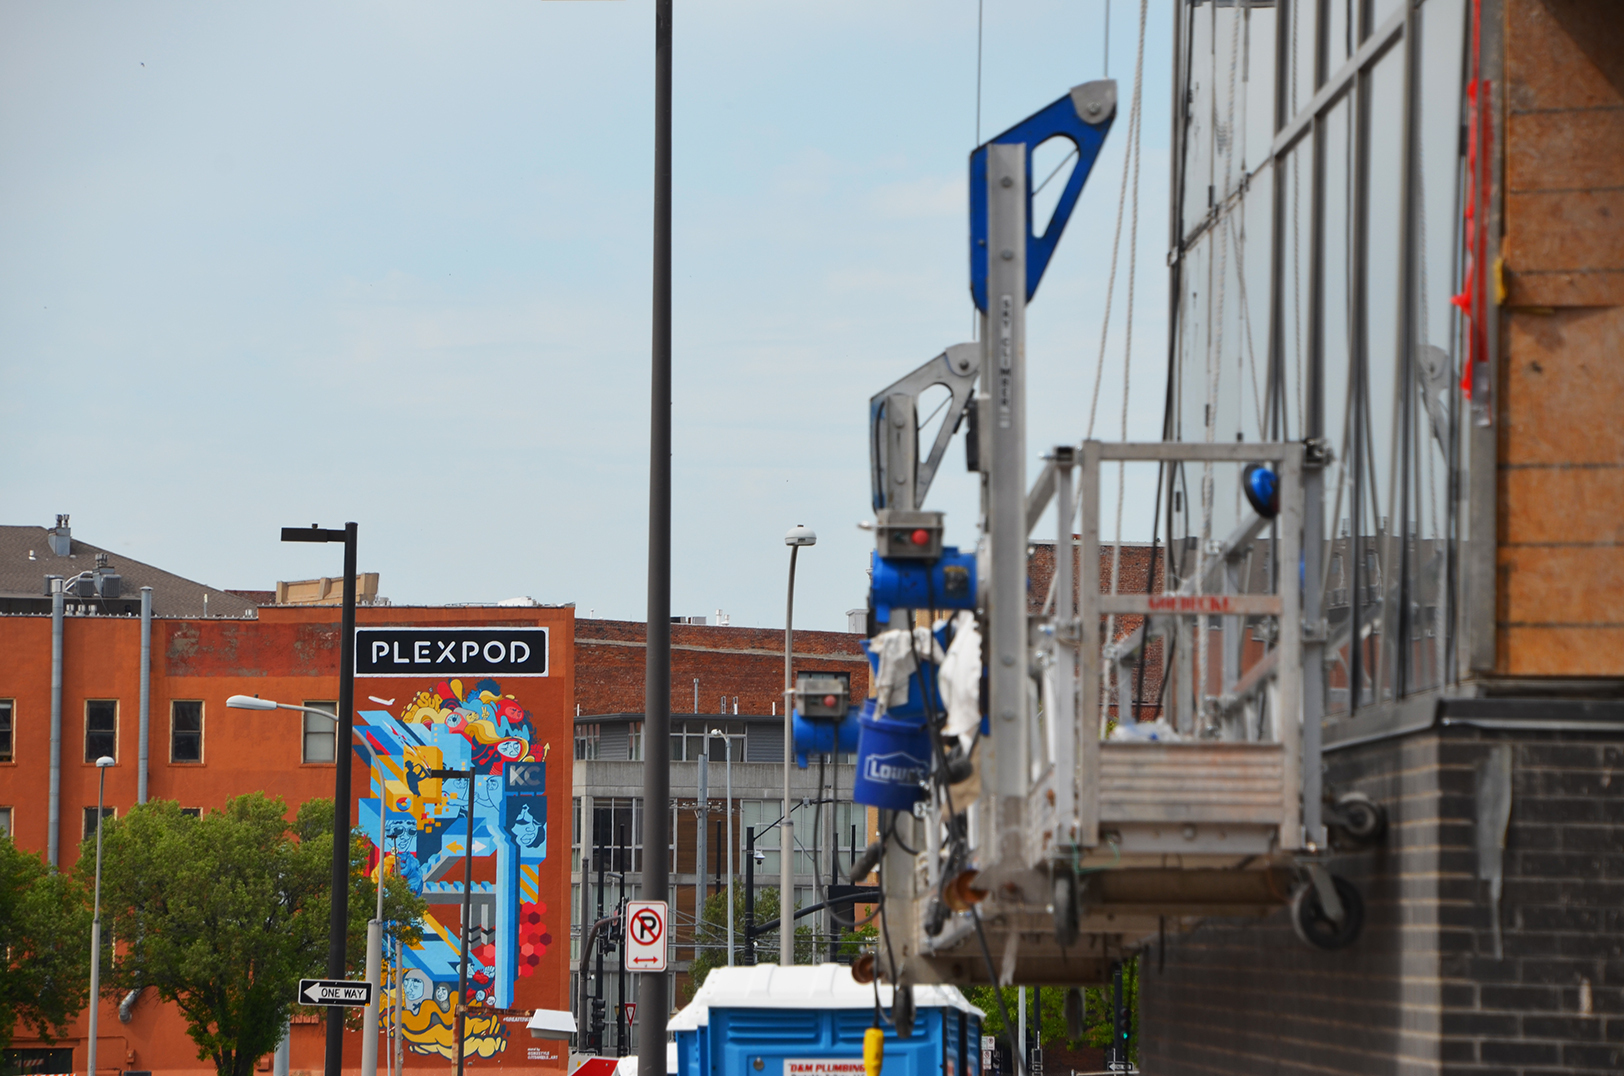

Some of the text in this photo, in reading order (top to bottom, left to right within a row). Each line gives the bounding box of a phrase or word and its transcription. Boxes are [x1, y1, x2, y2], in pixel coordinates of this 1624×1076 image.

[371, 640, 531, 664] PLEXPOD
[509, 765, 541, 786] KC
[321, 988, 364, 999] ONE WAY
[790, 1064, 866, 1073] D&M PLUMBING
